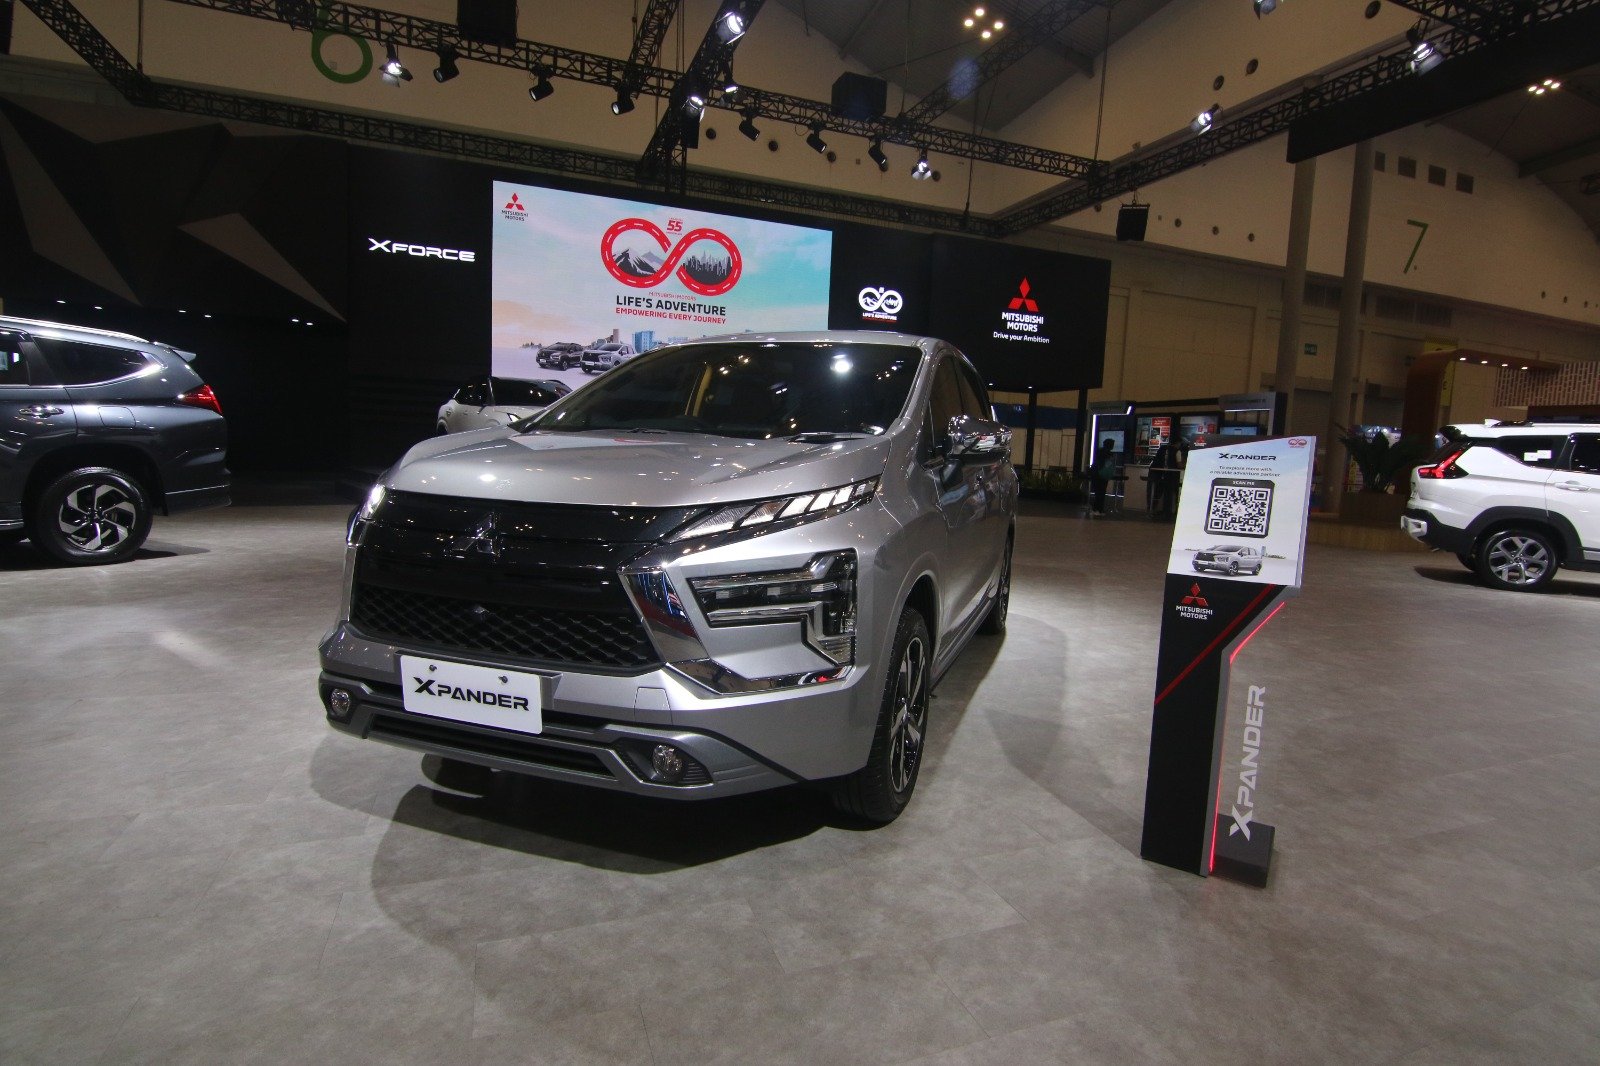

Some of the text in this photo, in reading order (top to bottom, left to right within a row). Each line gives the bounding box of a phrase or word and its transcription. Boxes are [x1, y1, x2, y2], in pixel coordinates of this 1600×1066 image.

[666, 220, 683, 232] 55
[368, 238, 476, 262] XFORCE
[1403, 219, 1429, 274] 7
[616, 295, 726, 316] LIFE'S ADVENTURE
[615, 308, 726, 324] EMPOWERING EVERY JOURNEY
[1001, 311, 1044, 325] MITSUBISHI
[1006, 321, 1038, 333] MOTORS
[993, 331, 1050, 344] Drive your Ambition
[1218, 452, 1277, 461] XPANDER
[1175, 605, 1213, 616] MITSUBISHI
[1180, 611, 1208, 620] MOTORS
[413, 676, 529, 711] XPANDER
[1229, 684, 1266, 842] XPANDER
